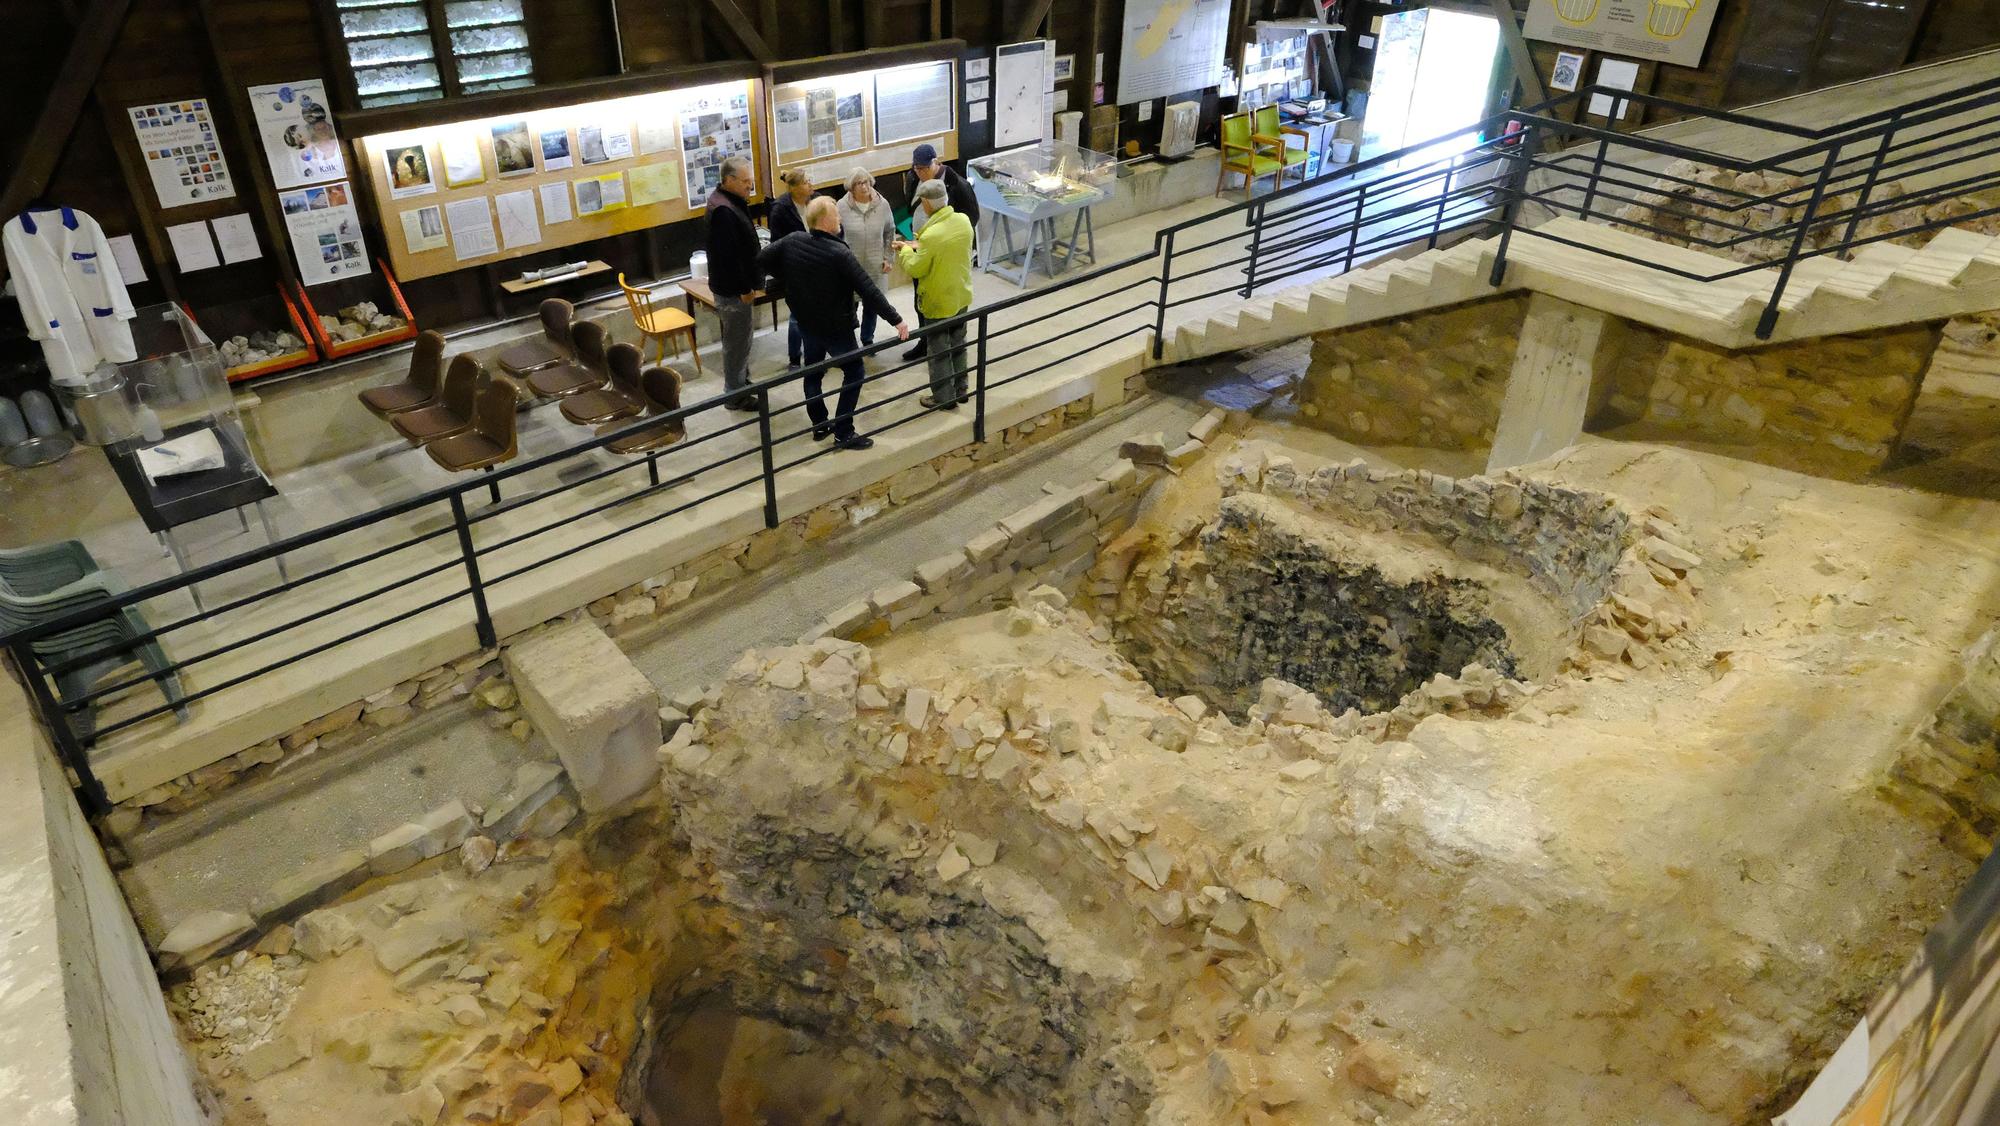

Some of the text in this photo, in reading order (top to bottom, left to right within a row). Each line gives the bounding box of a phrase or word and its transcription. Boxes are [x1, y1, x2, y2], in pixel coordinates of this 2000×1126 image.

[319, 164, 337, 173] Kalk
[207, 184, 228, 194] Kalk
[345, 260, 361, 270] Kalk
